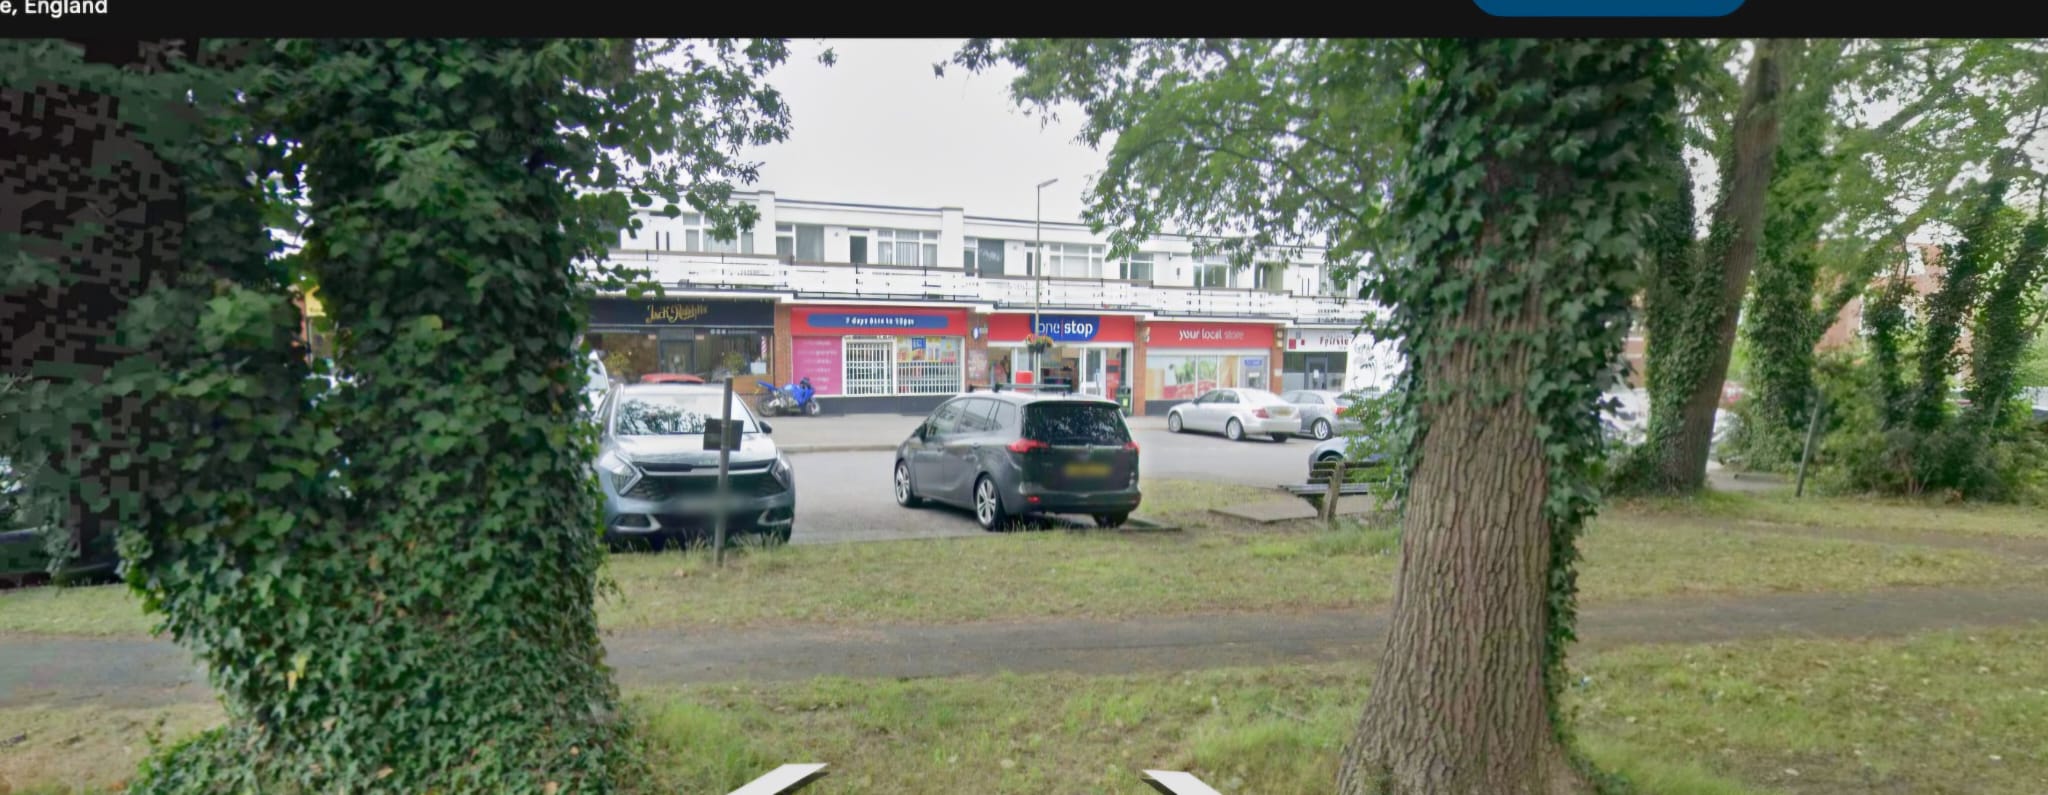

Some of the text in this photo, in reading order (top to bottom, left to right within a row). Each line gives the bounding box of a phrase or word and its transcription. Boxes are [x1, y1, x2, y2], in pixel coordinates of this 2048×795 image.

[1038, 320, 1094, 338] one stop
[1179, 329, 1200, 341] your
[1201, 328, 1222, 340] local
